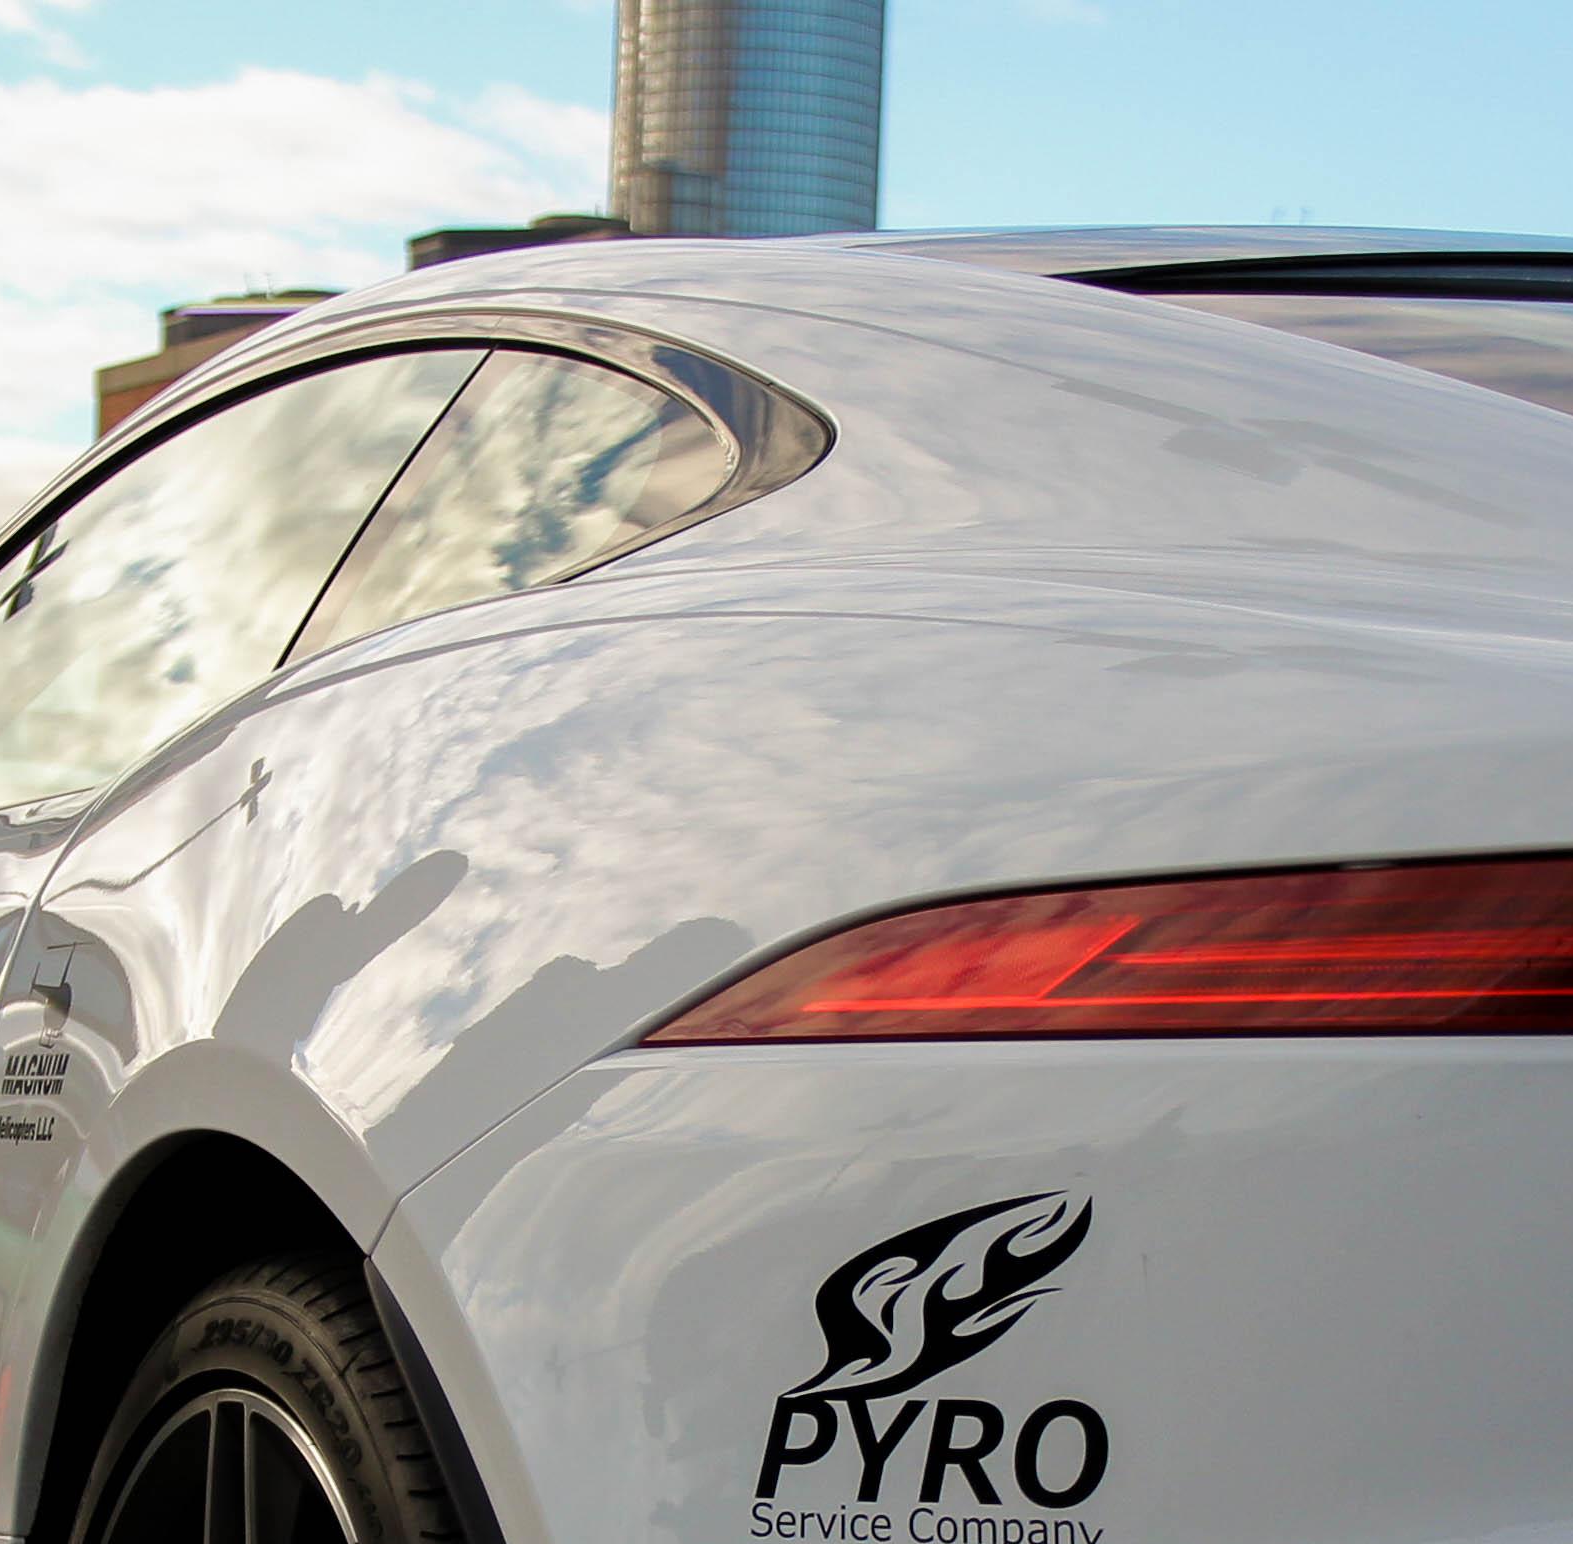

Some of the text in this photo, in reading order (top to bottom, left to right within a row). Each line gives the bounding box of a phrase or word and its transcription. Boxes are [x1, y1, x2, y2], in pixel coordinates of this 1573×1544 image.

[1, 1053, 70, 1095] MAGNUM
[35, 1116, 55, 1141] LLC
[754, 1397, 1109, 1509] PYRO
[750, 1502, 892, 1542] Service
